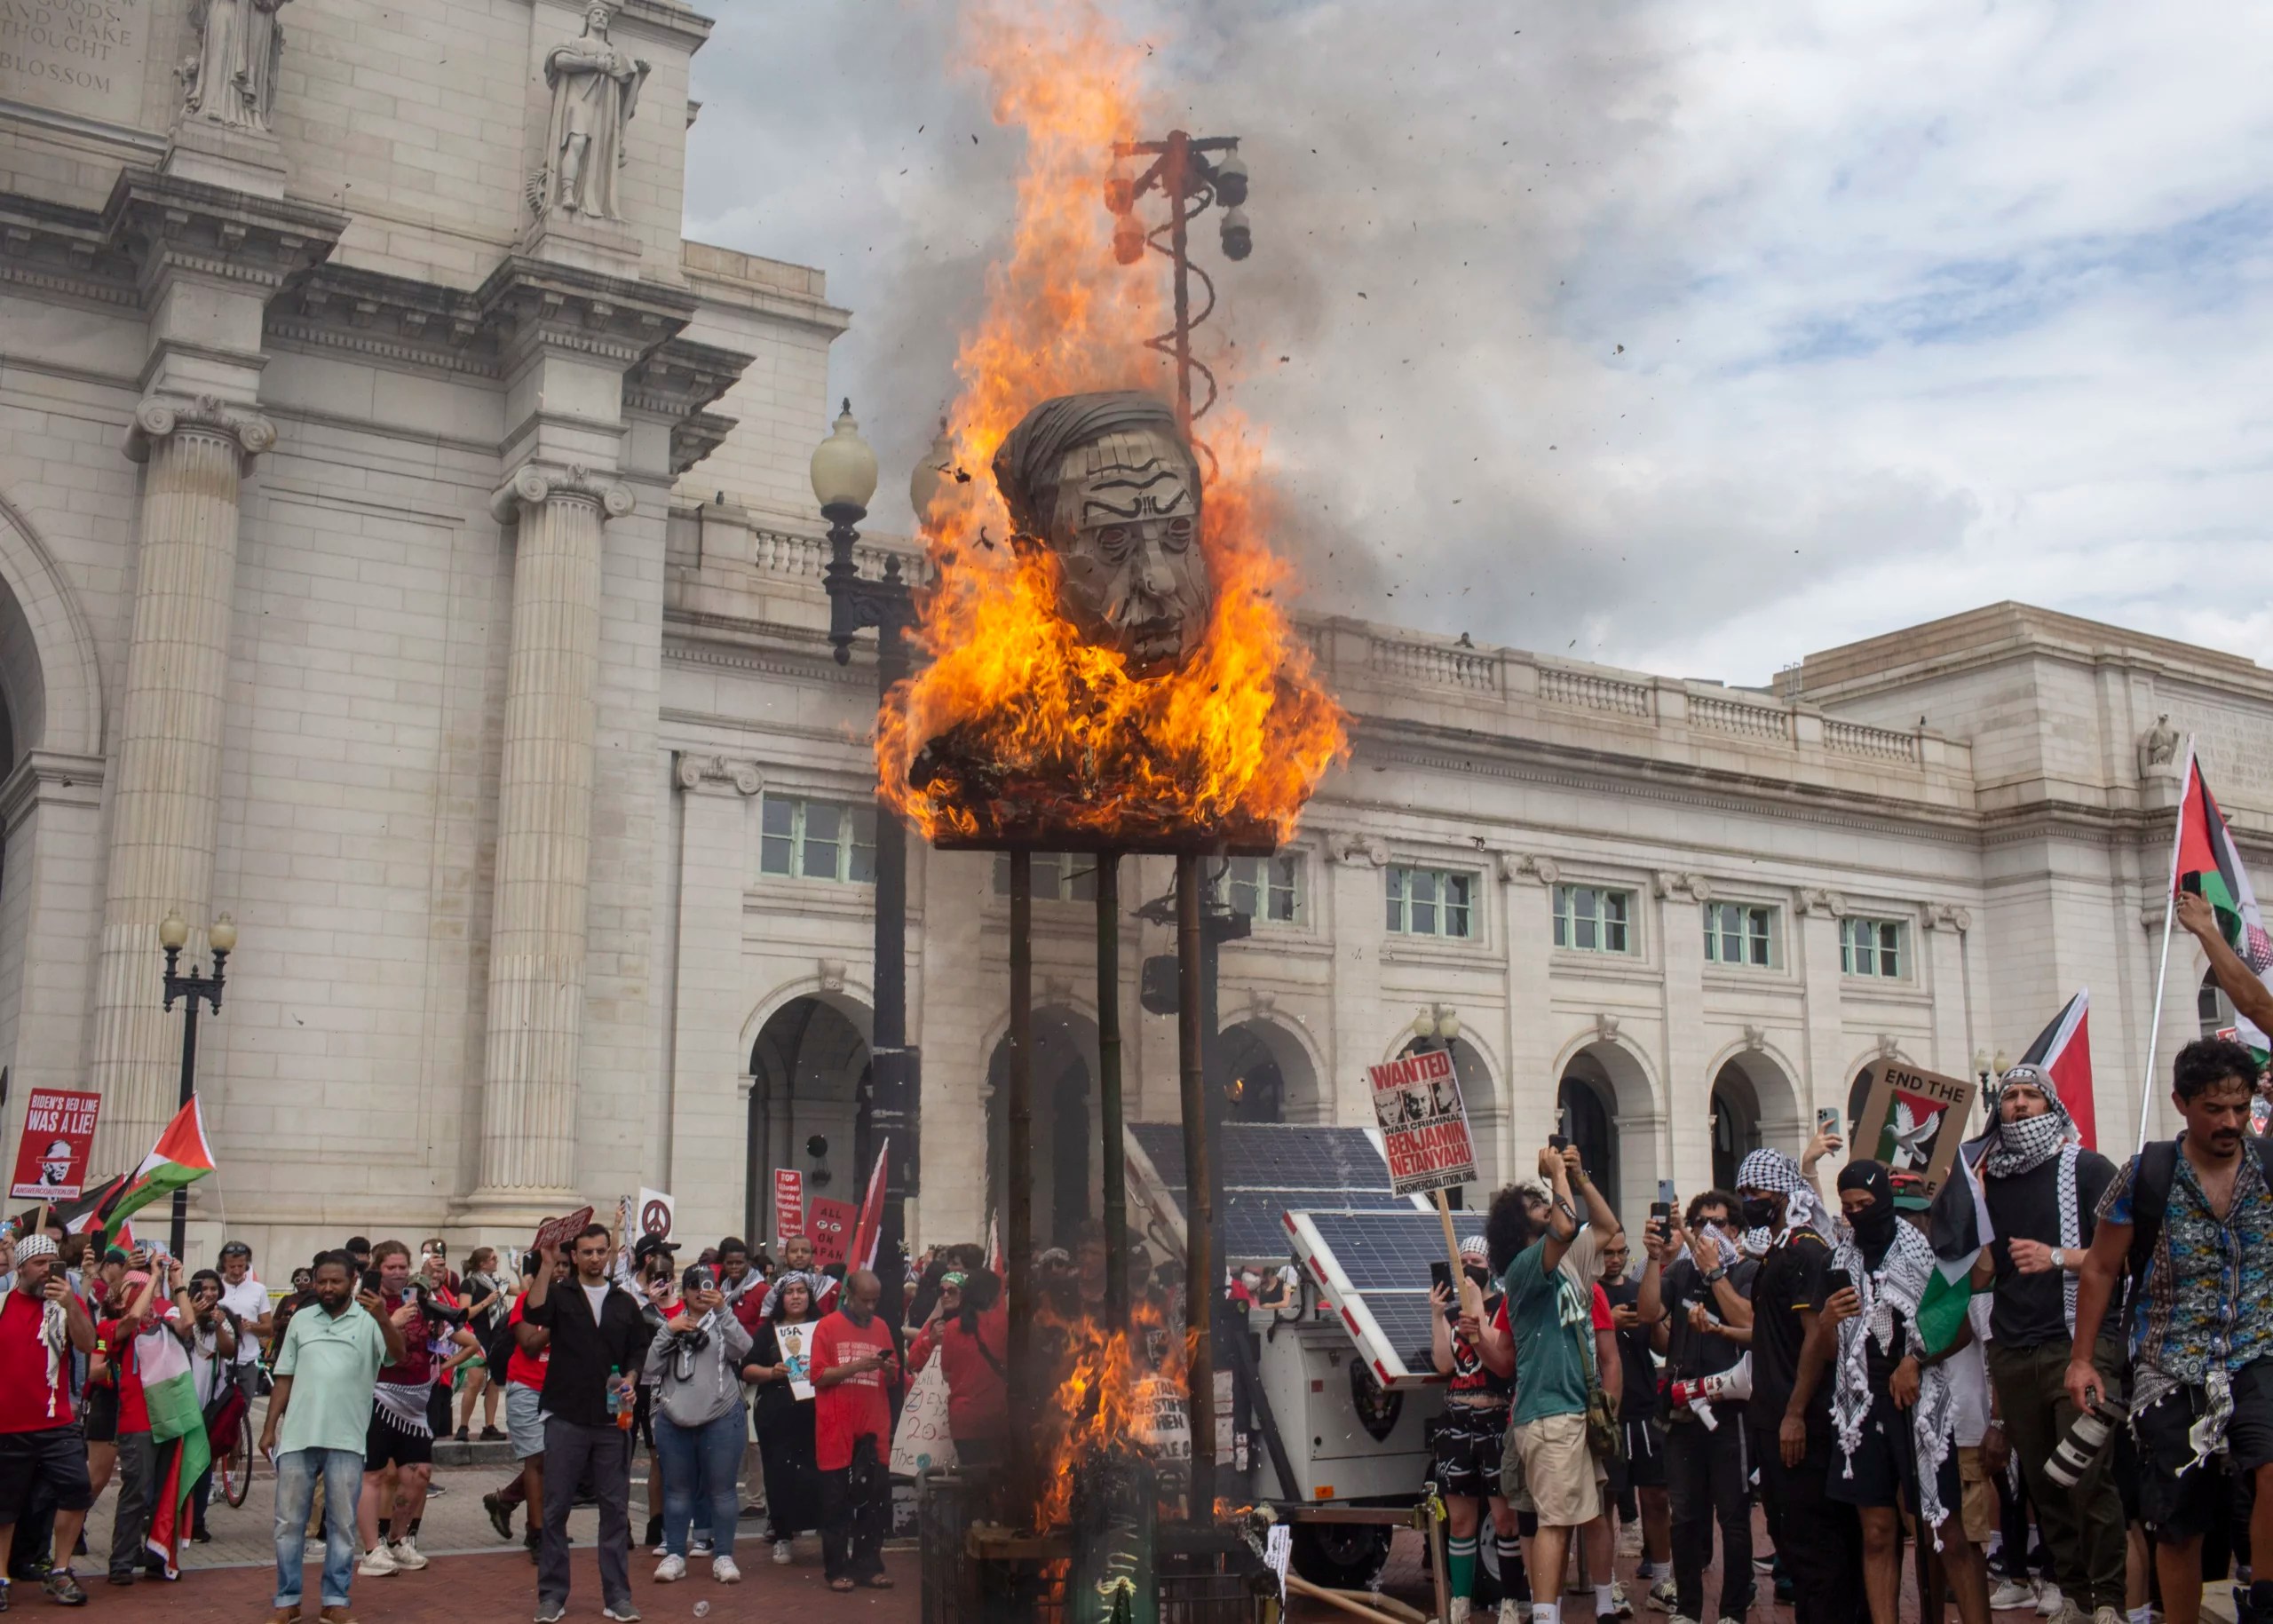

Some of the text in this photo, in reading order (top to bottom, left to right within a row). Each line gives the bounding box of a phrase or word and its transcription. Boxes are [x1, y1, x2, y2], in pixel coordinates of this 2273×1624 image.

[0, 20, 111, 60] THOUGHT
[66, 16, 131, 46] MAKE
[0, 51, 110, 92] BLOSSOM
[1370, 1050, 1450, 1090] WANTED
[1884, 1068, 1966, 1104] END THE
[31, 1095, 99, 1113] BIDEN'S RED LINE
[28, 1110, 95, 1135] WAS A LIE!
[1383, 1113, 1462, 1136] WAR CRIMINAL
[1385, 1121, 1468, 1157] BENJAMIN
[1389, 1143, 1472, 1177] NETANYAHU
[1396, 1170, 1477, 1196] ANSWERCOALITION.ORG
[820, 1207, 842, 1219] ALL
[817, 1232, 834, 1245] ON
[780, 1327, 803, 1337] USA
[892, 1446, 915, 1468] The
